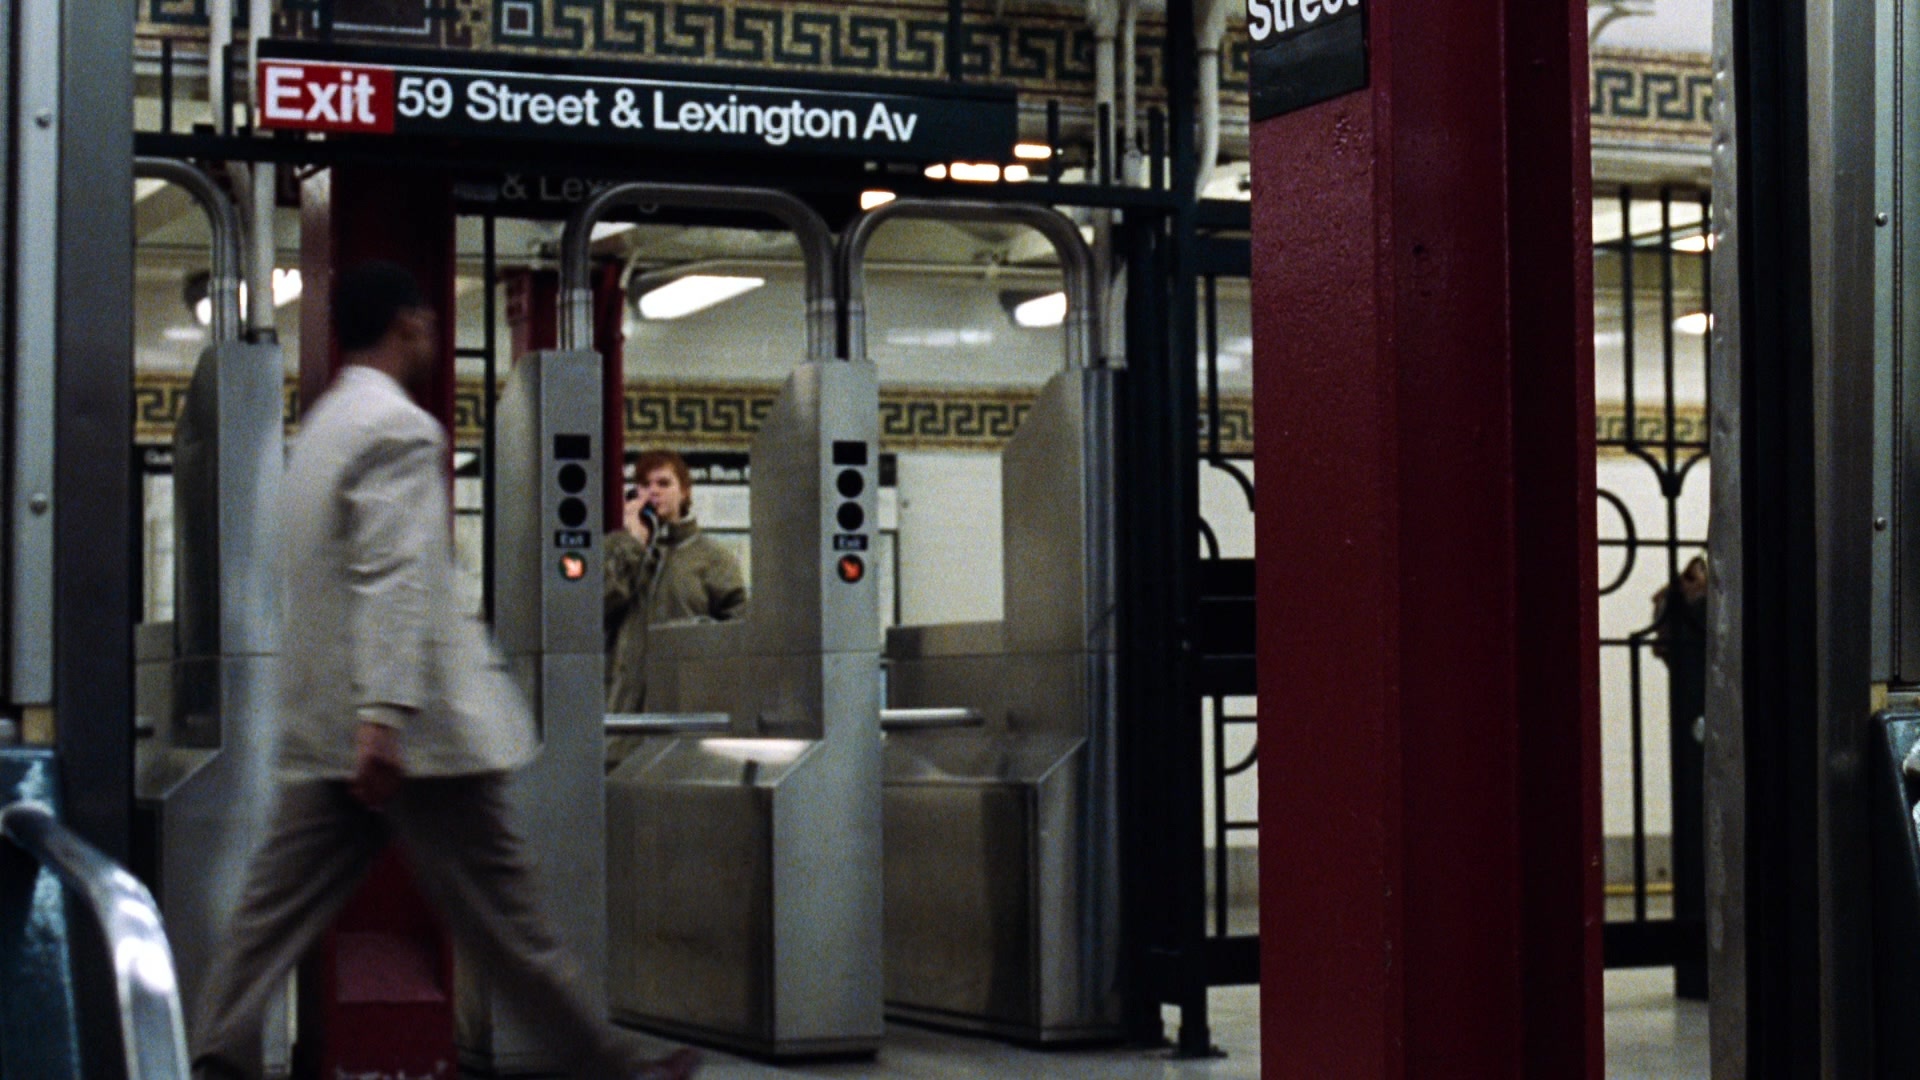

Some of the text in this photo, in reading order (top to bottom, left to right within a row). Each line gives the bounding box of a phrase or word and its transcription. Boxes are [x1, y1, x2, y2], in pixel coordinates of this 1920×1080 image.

[1248, 0, 1359, 41] Stre
[264, 66, 917, 146] Exit 59 Street & Lexington Av
